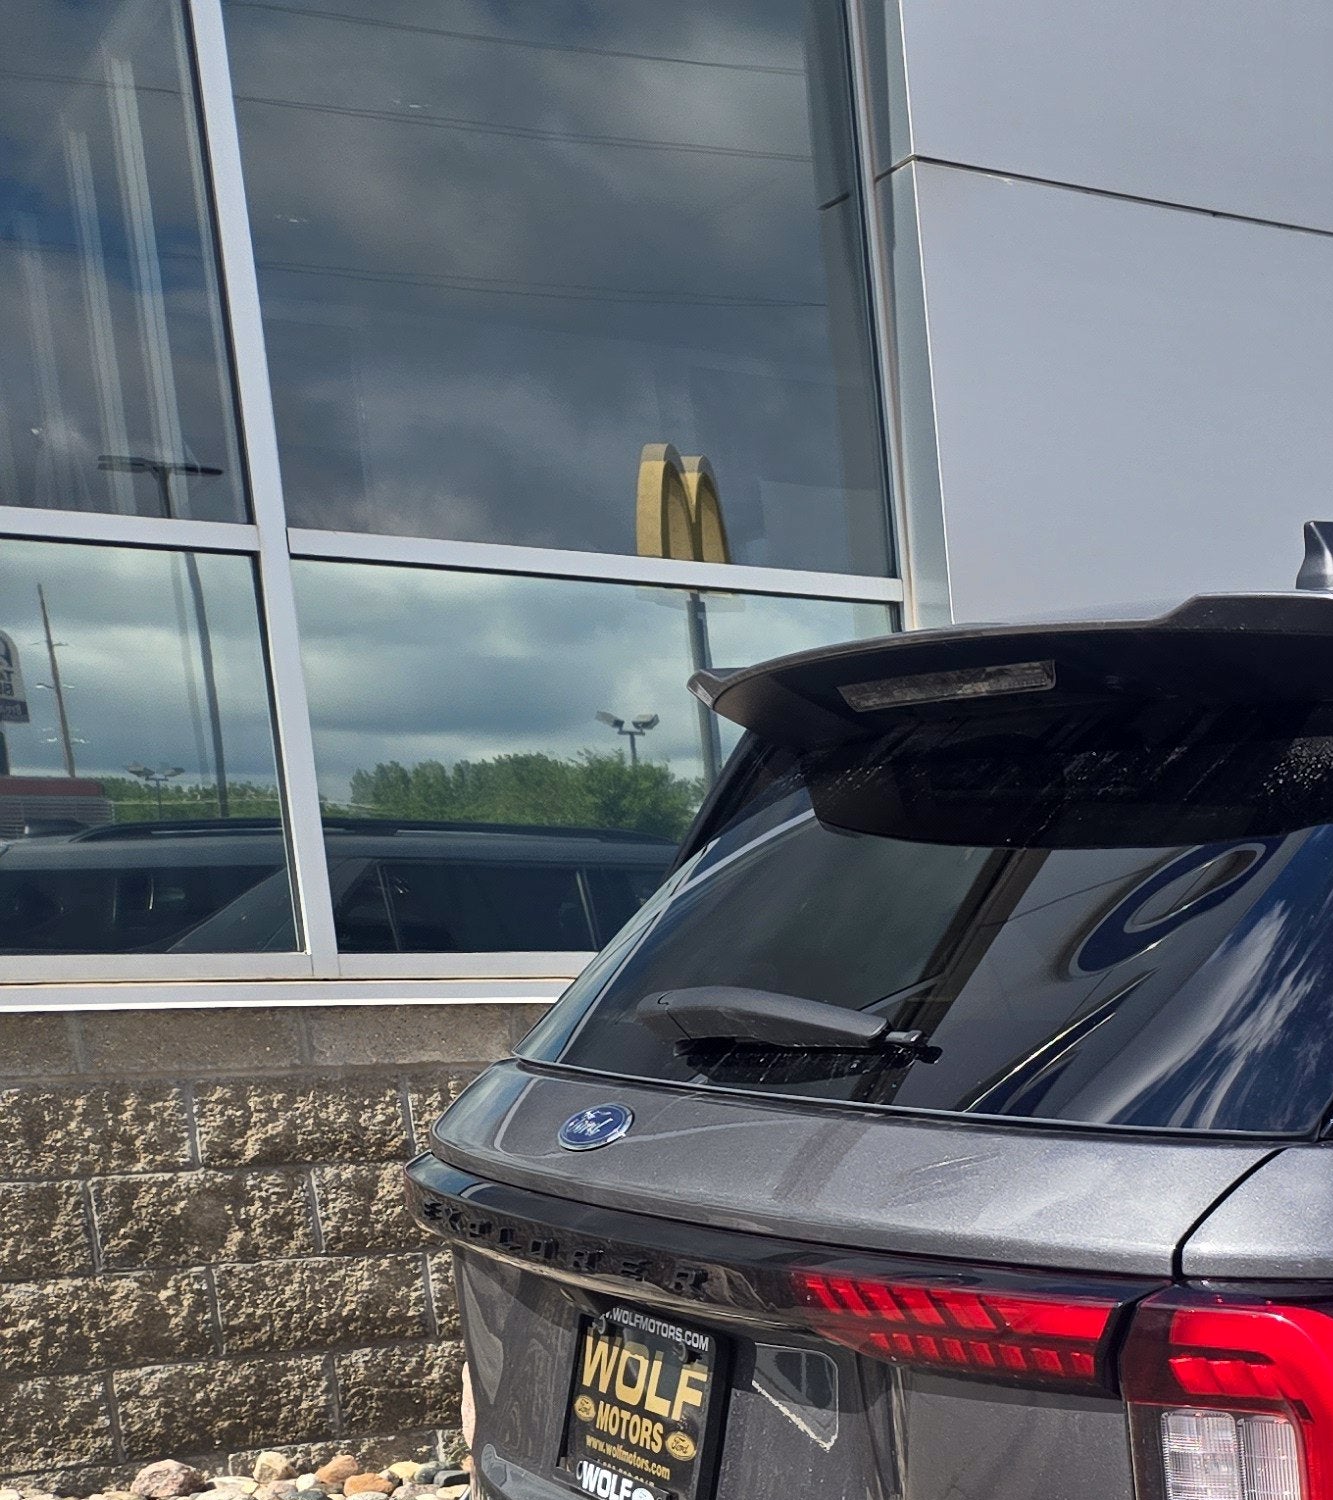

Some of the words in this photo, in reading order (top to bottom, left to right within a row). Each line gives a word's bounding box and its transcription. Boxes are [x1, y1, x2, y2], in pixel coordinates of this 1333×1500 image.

[422, 1198, 706, 1302] EXPLORER
[582, 1327, 709, 1421] WOLF
[585, 1434, 671, 1481] www.wolfmotors.com
[596, 1400, 664, 1454] MOTORS
